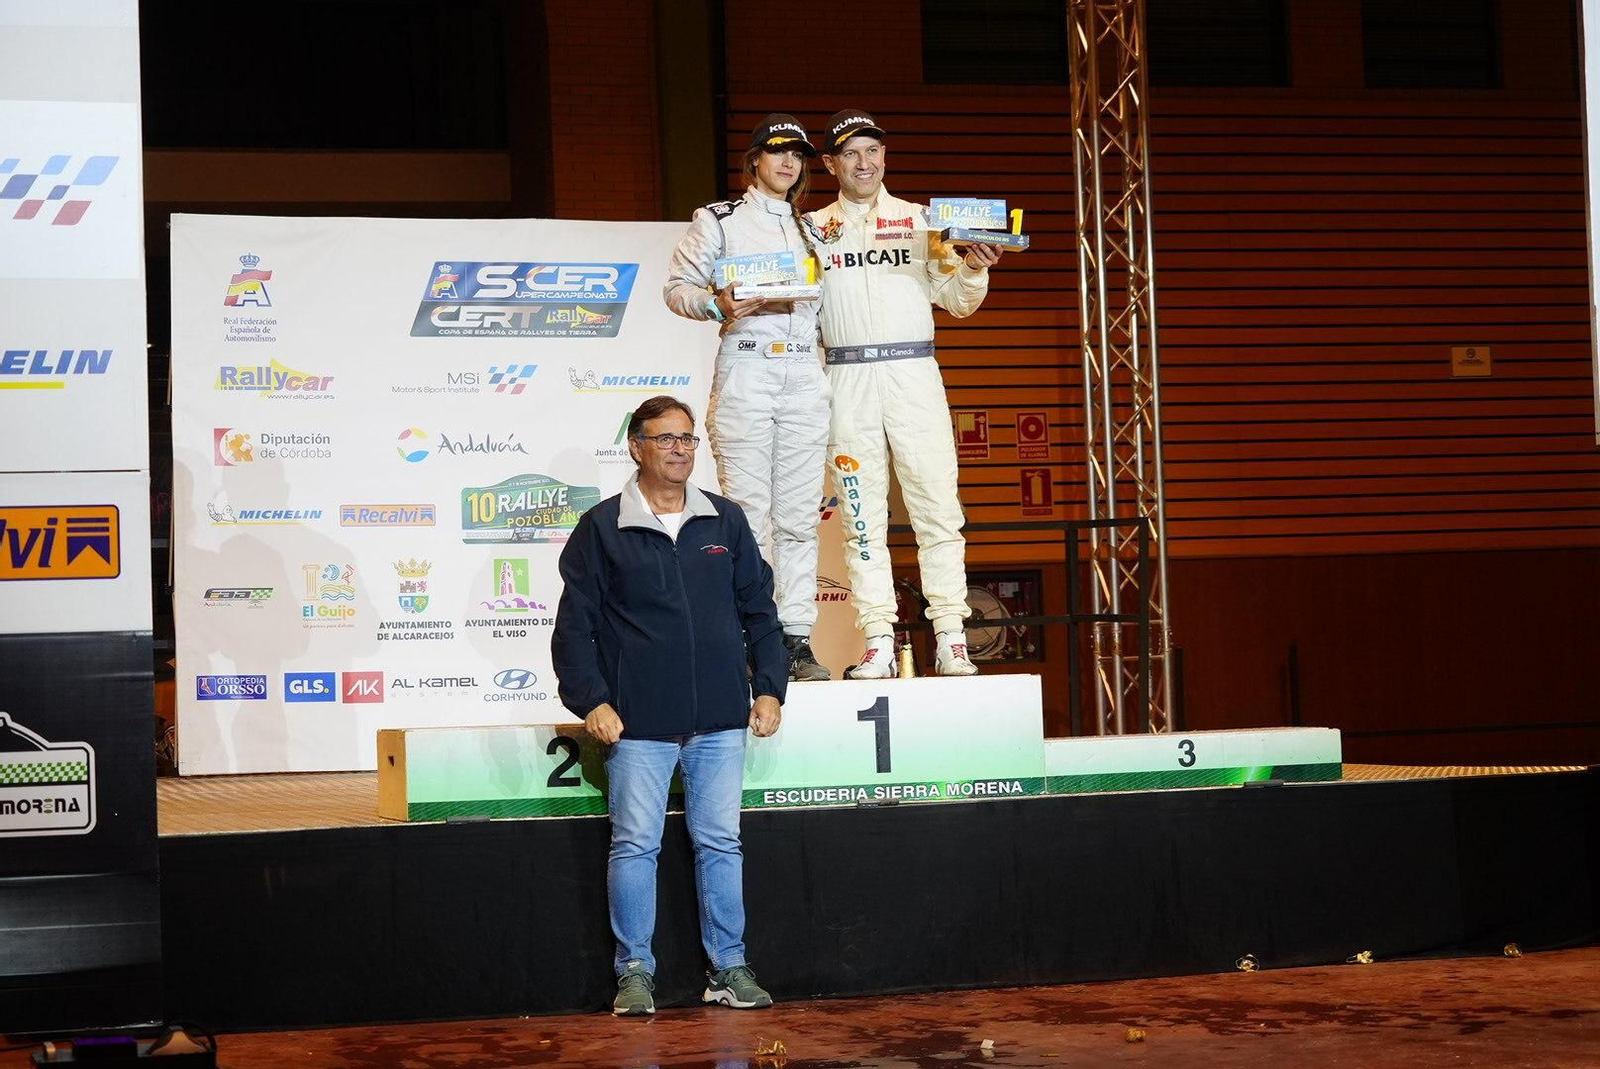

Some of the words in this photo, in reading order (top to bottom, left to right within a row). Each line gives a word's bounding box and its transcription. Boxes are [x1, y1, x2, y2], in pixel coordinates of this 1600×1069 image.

[937, 204, 952, 221] 10
[953, 206, 991, 217] RALLYE
[1010, 208, 1024, 235] 1
[738, 259, 779, 276] RALLYE
[803, 257, 816, 285] 1
[223, 317, 238, 325] Real
[430, 305, 543, 329] CERT
[738, 341, 757, 350] OMP
[220, 365, 335, 392] Rallycar
[601, 375, 691, 387] MICHELIN
[260, 433, 331, 447] Diputación
[437, 432, 530, 456] Andalucía
[260, 447, 276, 459] de
[280, 446, 332, 459] Córdoba
[595, 449, 617, 457] Junta
[468, 492, 496, 523] 10
[498, 487, 569, 514] RALLYE
[536, 506, 561, 516] CIUDAD
[563, 505, 574, 513] DE
[239, 510, 323, 520] MICHELIN
[358, 507, 419, 523] Recalvi
[507, 510, 584, 528] POZOBLANC
[303, 605, 314, 617] El
[317, 605, 356, 620] Guijo
[378, 621, 452, 629] AYUNTAMIENTO
[464, 618, 539, 628] AYUNTAMIENTO
[541, 618, 555, 626] DE
[377, 633, 390, 641] DE
[392, 631, 455, 641] ALCARACEJOS
[493, 630, 504, 638] EL
[506, 629, 527, 638] VISO
[217, 684, 266, 695] ORSSO
[391, 678, 414, 689] AL
[483, 692, 548, 702] CORHYUND
[856, 696, 892, 774] 1
[1178, 739, 1197, 768] 3
[546, 735, 582, 788] 2
[763, 787, 868, 805] ESCUDERIA
[873, 784, 941, 800] SIERRA
[946, 780, 1024, 797] MORENA
